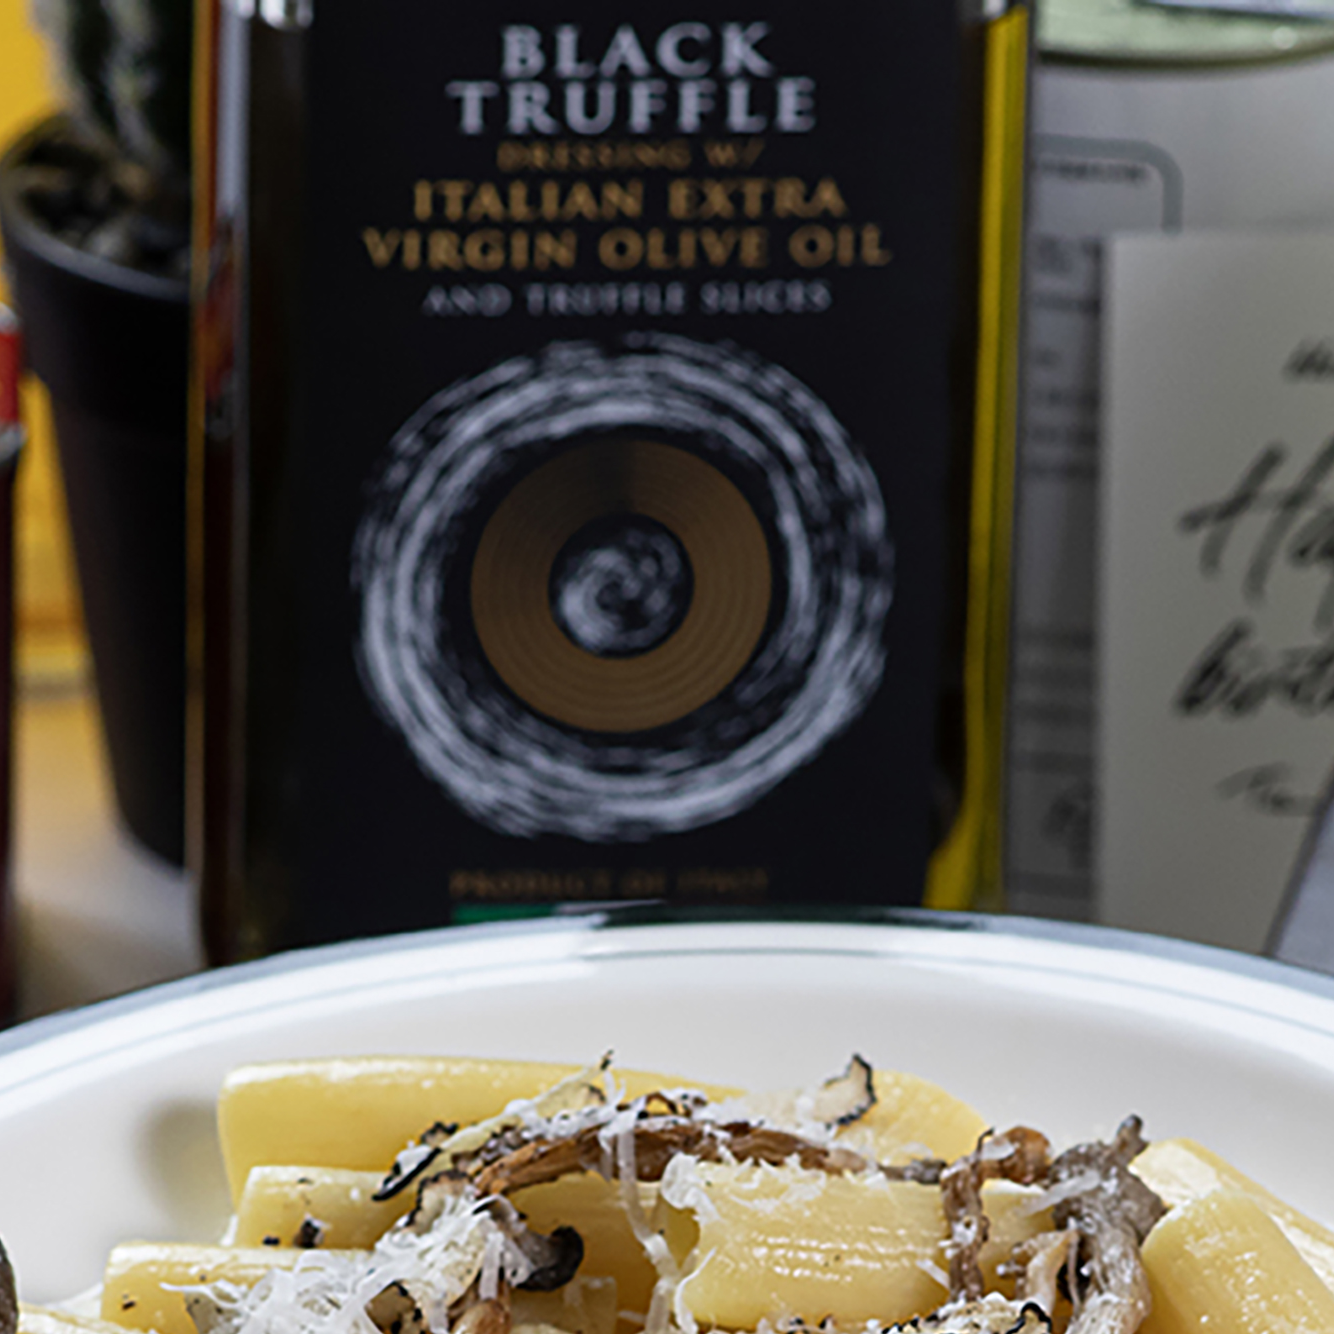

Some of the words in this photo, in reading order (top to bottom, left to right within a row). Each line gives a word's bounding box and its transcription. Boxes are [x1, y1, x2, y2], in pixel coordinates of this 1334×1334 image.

[501, 21, 772, 79] BLACK
[445, 76, 816, 135] TRUFFLE
[413, 179, 645, 222] ITALIAN
[669, 177, 847, 220] EXTRA
[362, 227, 577, 271] VIRGIN
[598, 226, 767, 269] OLIVE
[788, 223, 891, 267] OIL
[423, 282, 512, 316] AND
[525, 281, 686, 315] TRUFFLE
[700, 279, 832, 314] SLICES
